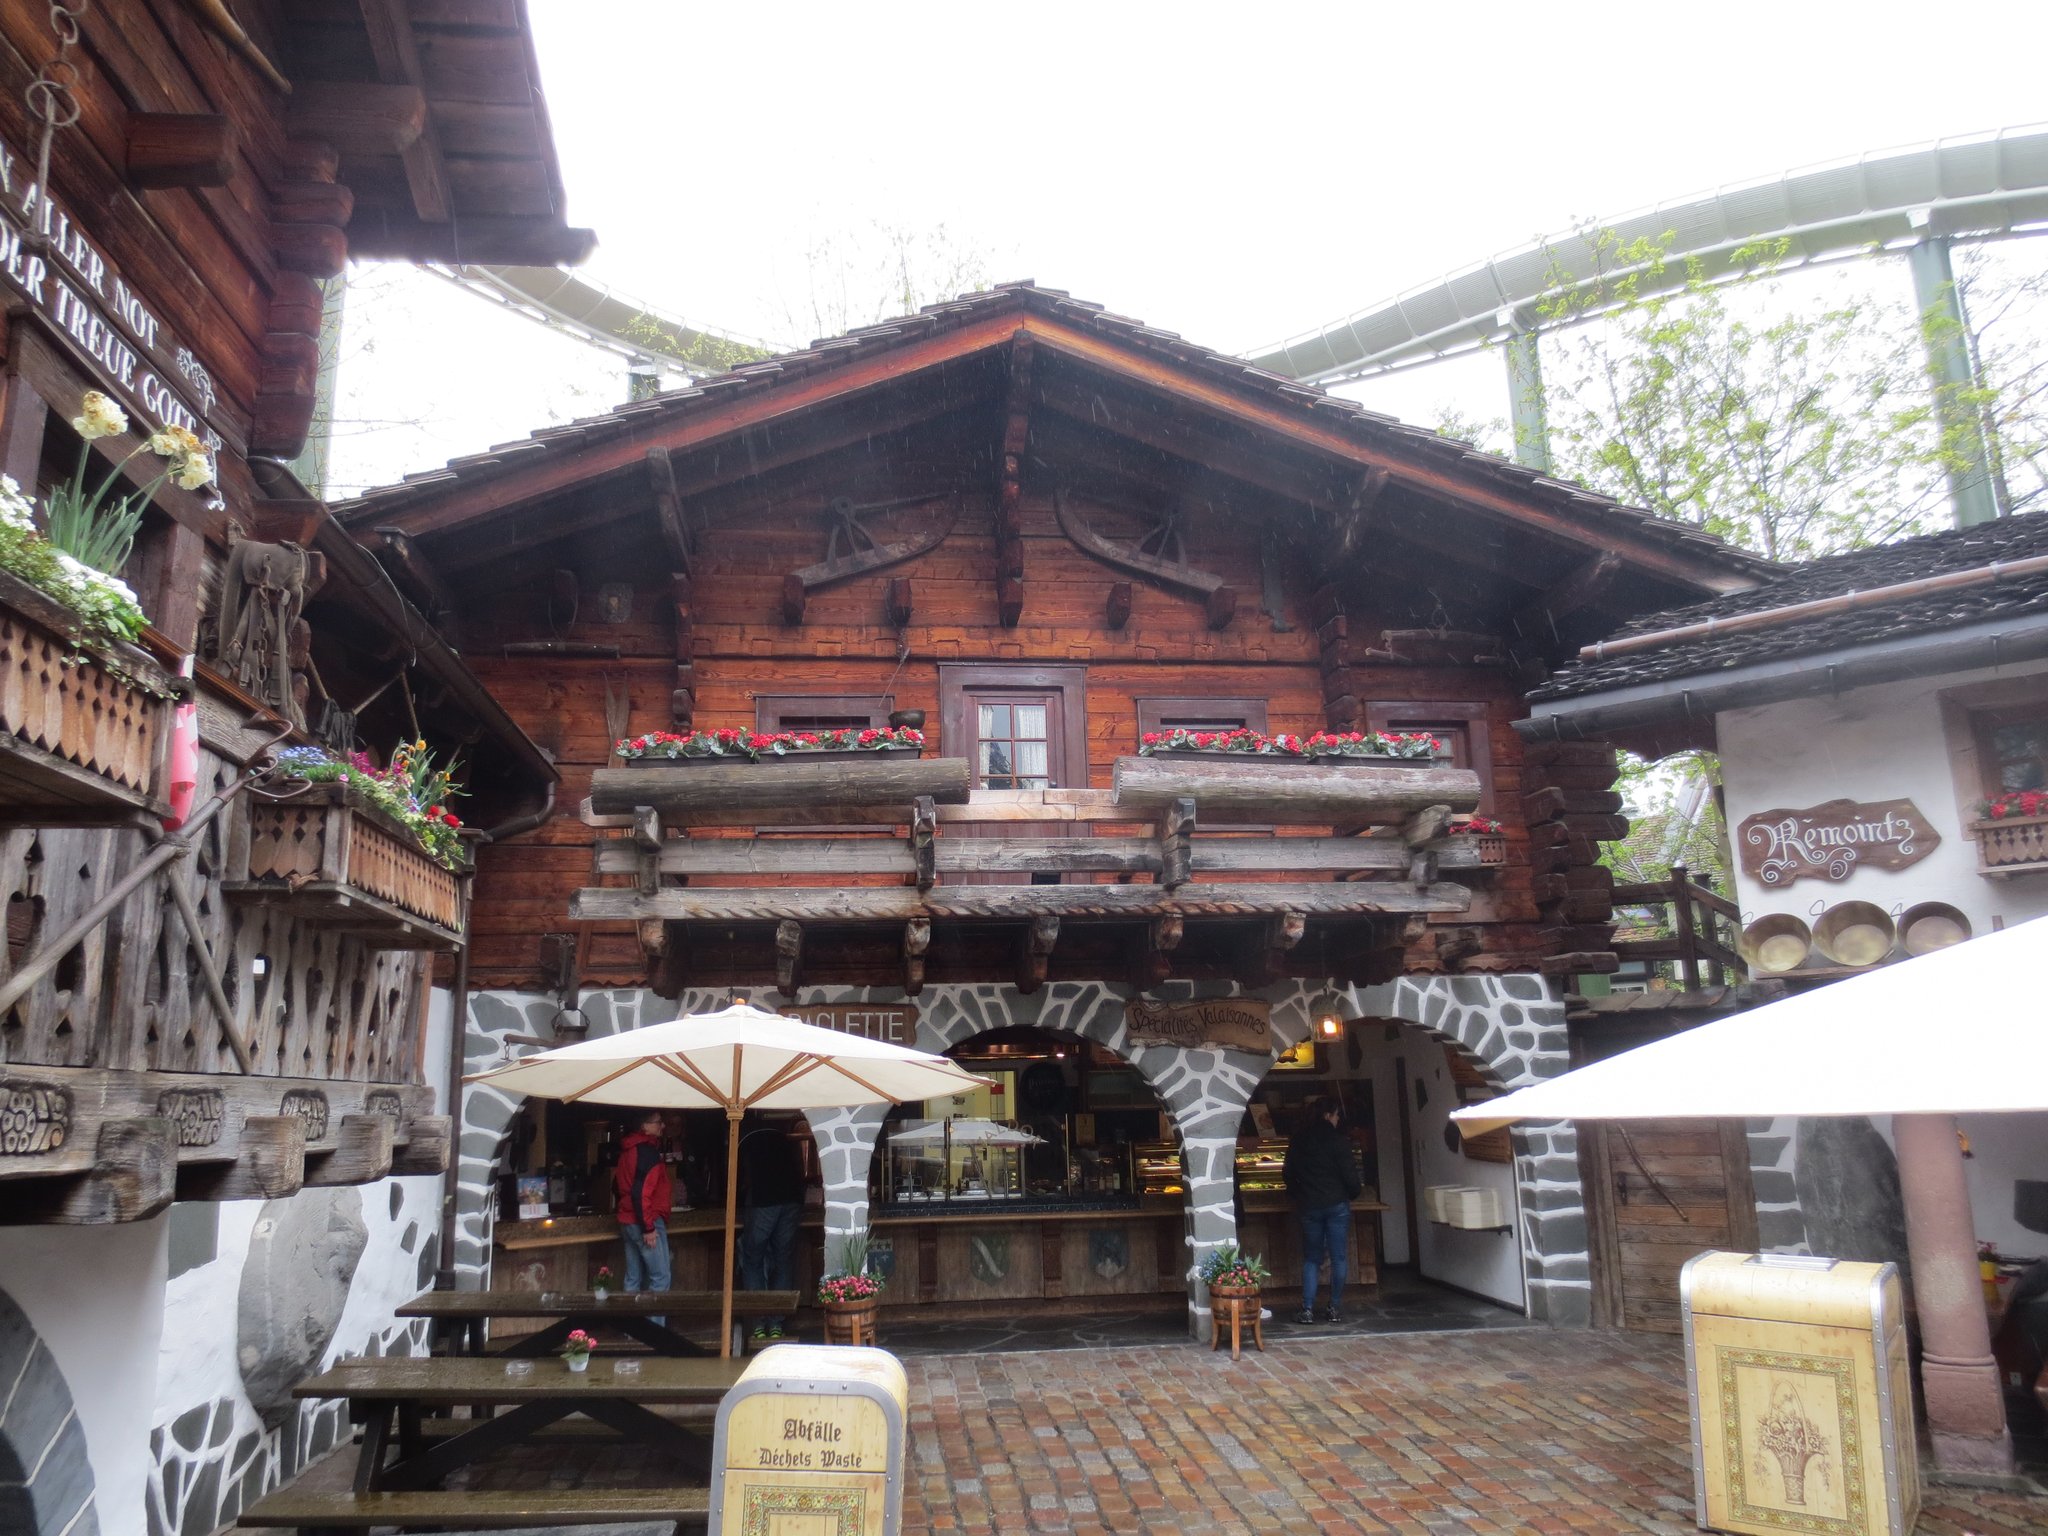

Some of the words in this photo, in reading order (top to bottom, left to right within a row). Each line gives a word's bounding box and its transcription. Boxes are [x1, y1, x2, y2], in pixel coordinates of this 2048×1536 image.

[113, 276, 160, 351] NOT
[54, 279, 138, 393] TREUE
[143, 372, 198, 432] GOTT
[1197, 1005, 1266, 1036] Valaisannes
[783, 1418, 842, 1442] Abfälle
[759, 1447, 812, 1468] Déchets
[820, 1449, 863, 1469] Waste
